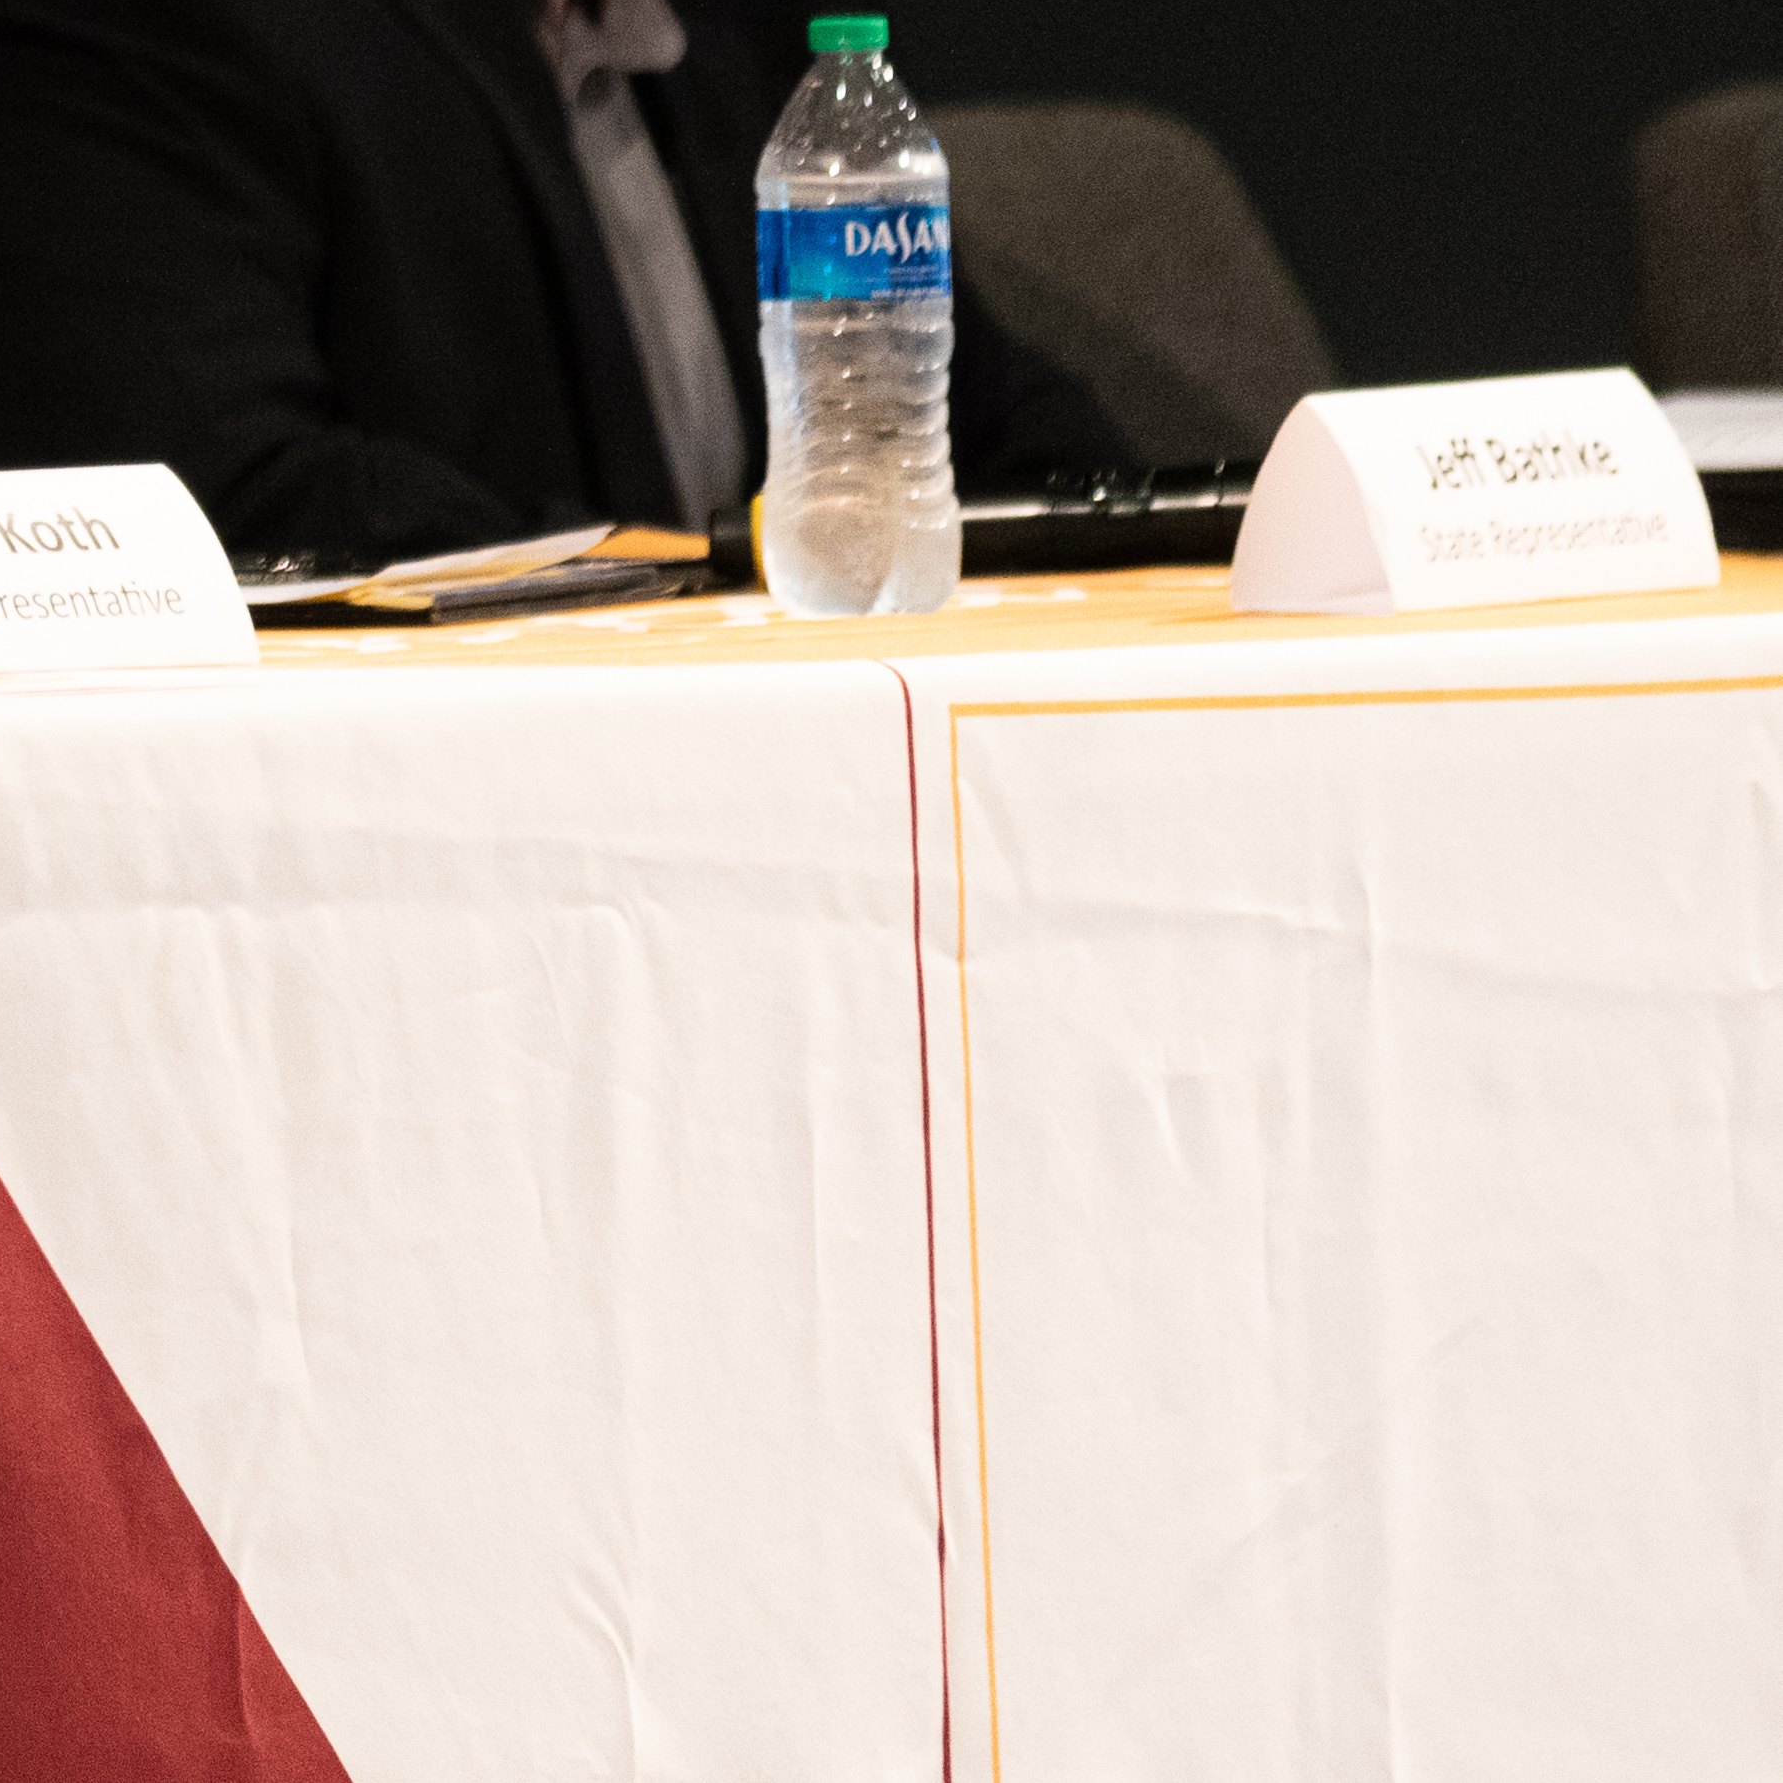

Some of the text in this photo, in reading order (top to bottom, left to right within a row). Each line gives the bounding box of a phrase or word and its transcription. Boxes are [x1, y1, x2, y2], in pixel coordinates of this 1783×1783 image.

[1417, 436, 1485, 490] Jeff
[1420, 512, 1669, 564] State Representative
